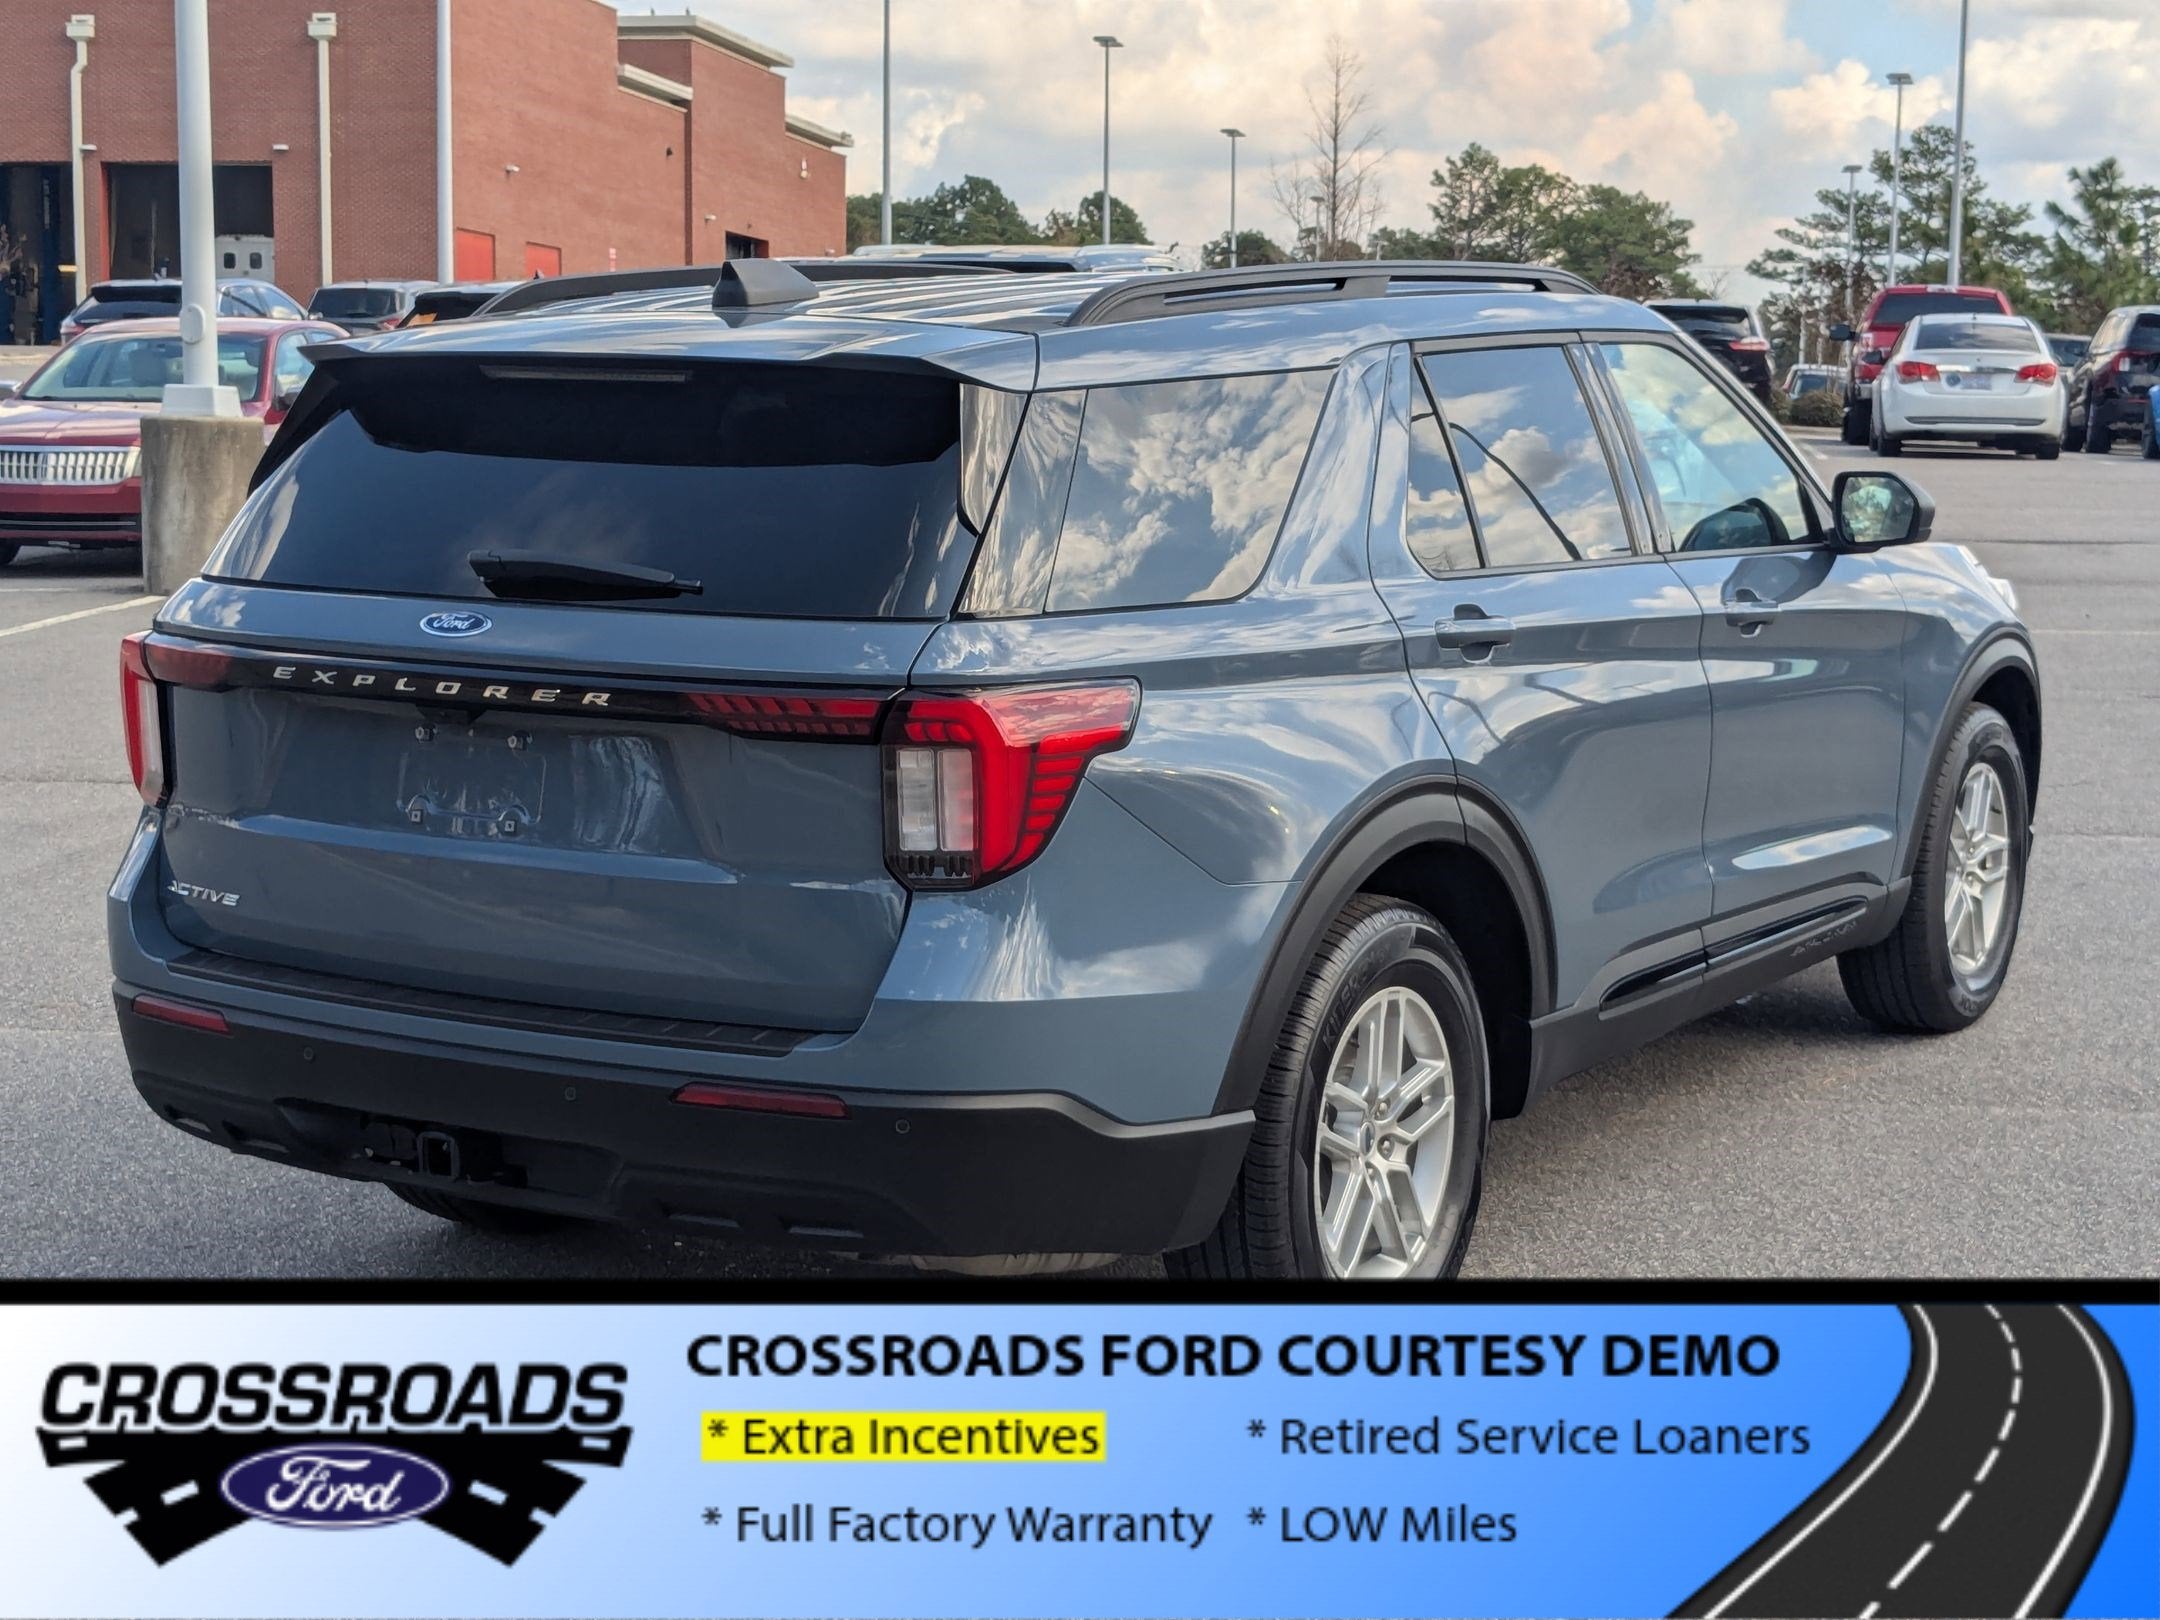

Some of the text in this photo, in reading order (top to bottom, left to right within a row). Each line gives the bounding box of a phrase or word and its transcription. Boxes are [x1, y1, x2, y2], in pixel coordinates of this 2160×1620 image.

[432, 613, 476, 630] Ford
[272, 665, 612, 707] EXPLORER
[166, 879, 241, 907] ACTIVE
